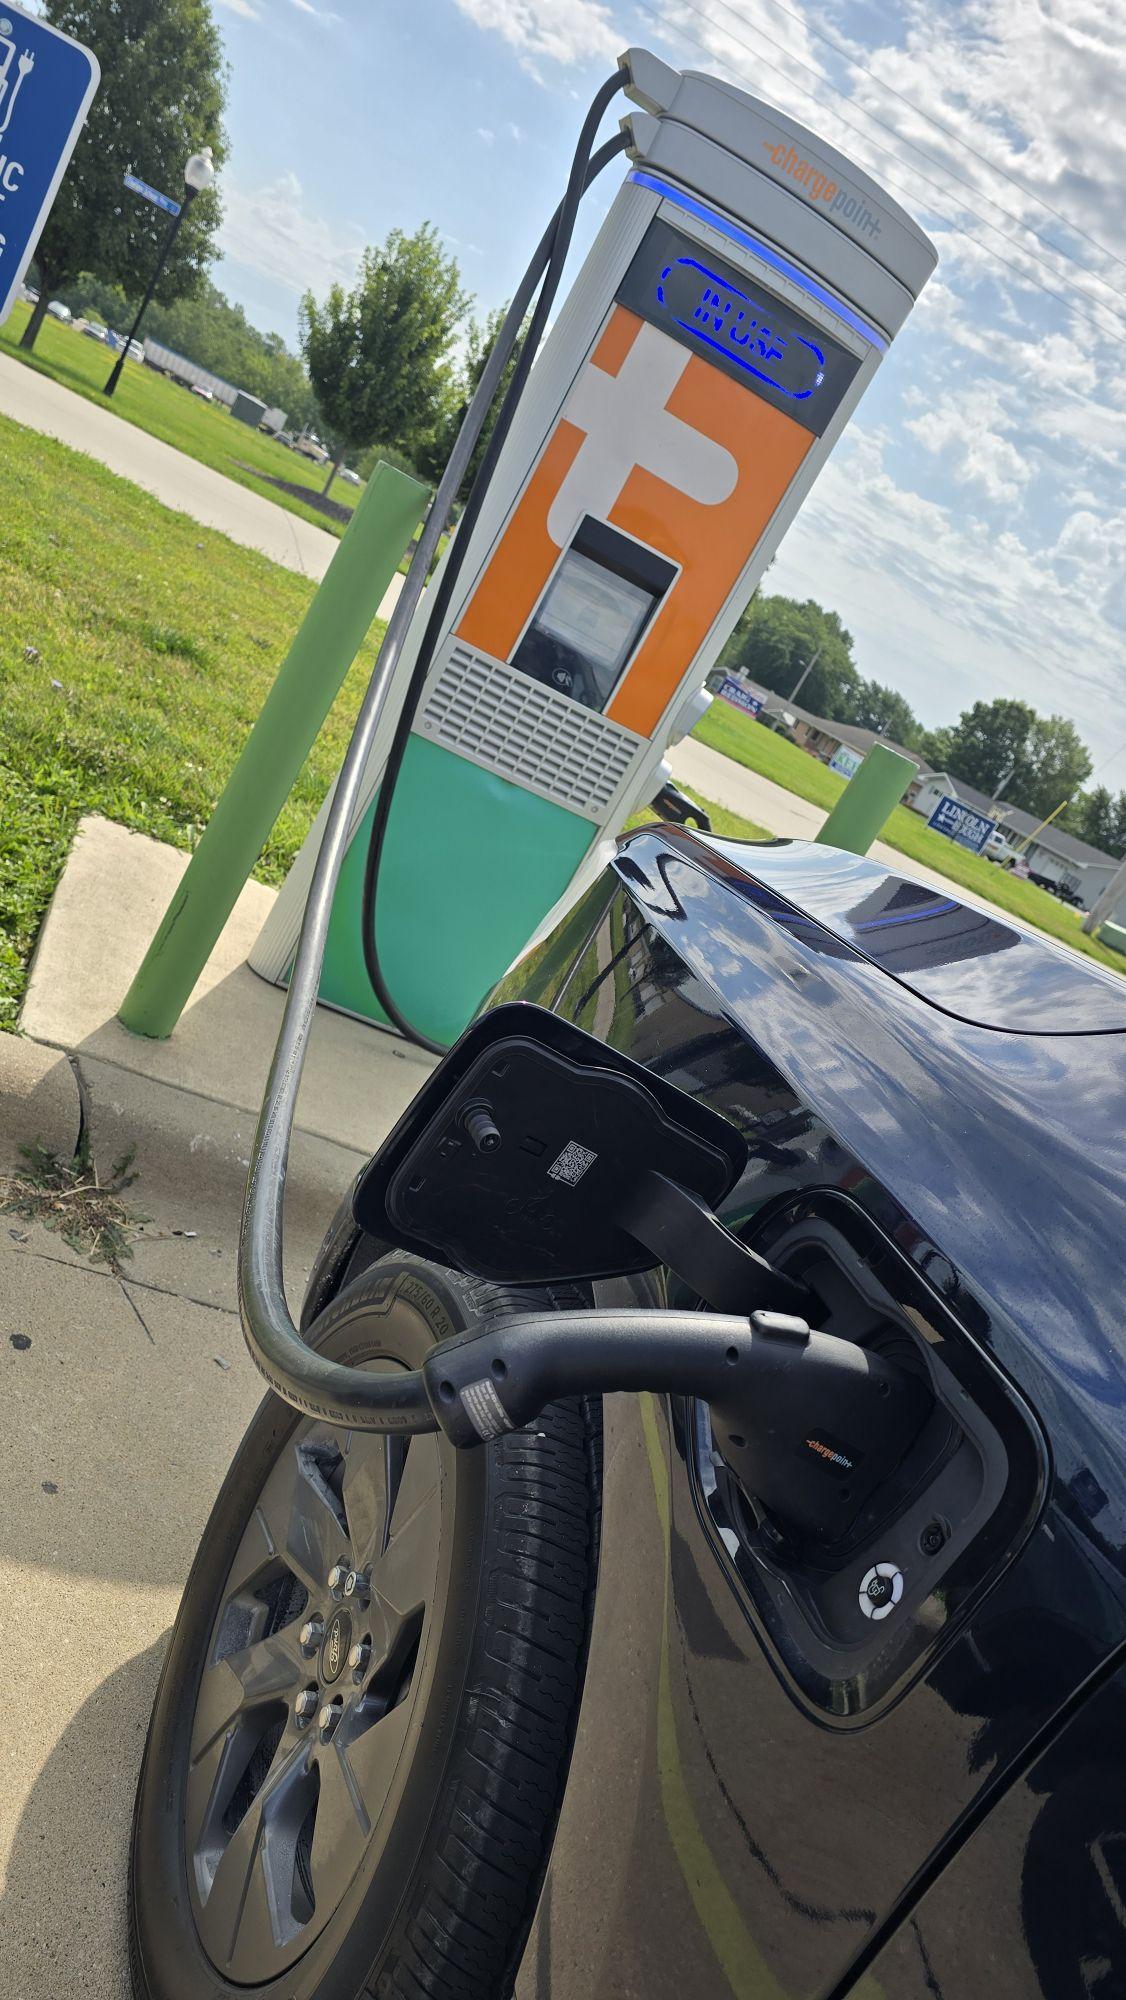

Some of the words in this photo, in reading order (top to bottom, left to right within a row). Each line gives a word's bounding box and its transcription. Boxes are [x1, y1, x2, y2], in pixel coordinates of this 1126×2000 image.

[768, 142, 882, 238] chargepoint
[694, 288, 732, 332] IN
[729, 311, 788, 363] USE
[941, 801, 991, 834] LINCOLN
[430, 1308, 440, 1320] R
[435, 1316, 449, 1336] 20
[807, 1440, 852, 1468] chargepoint
[329, 1627, 339, 1663] Ford
